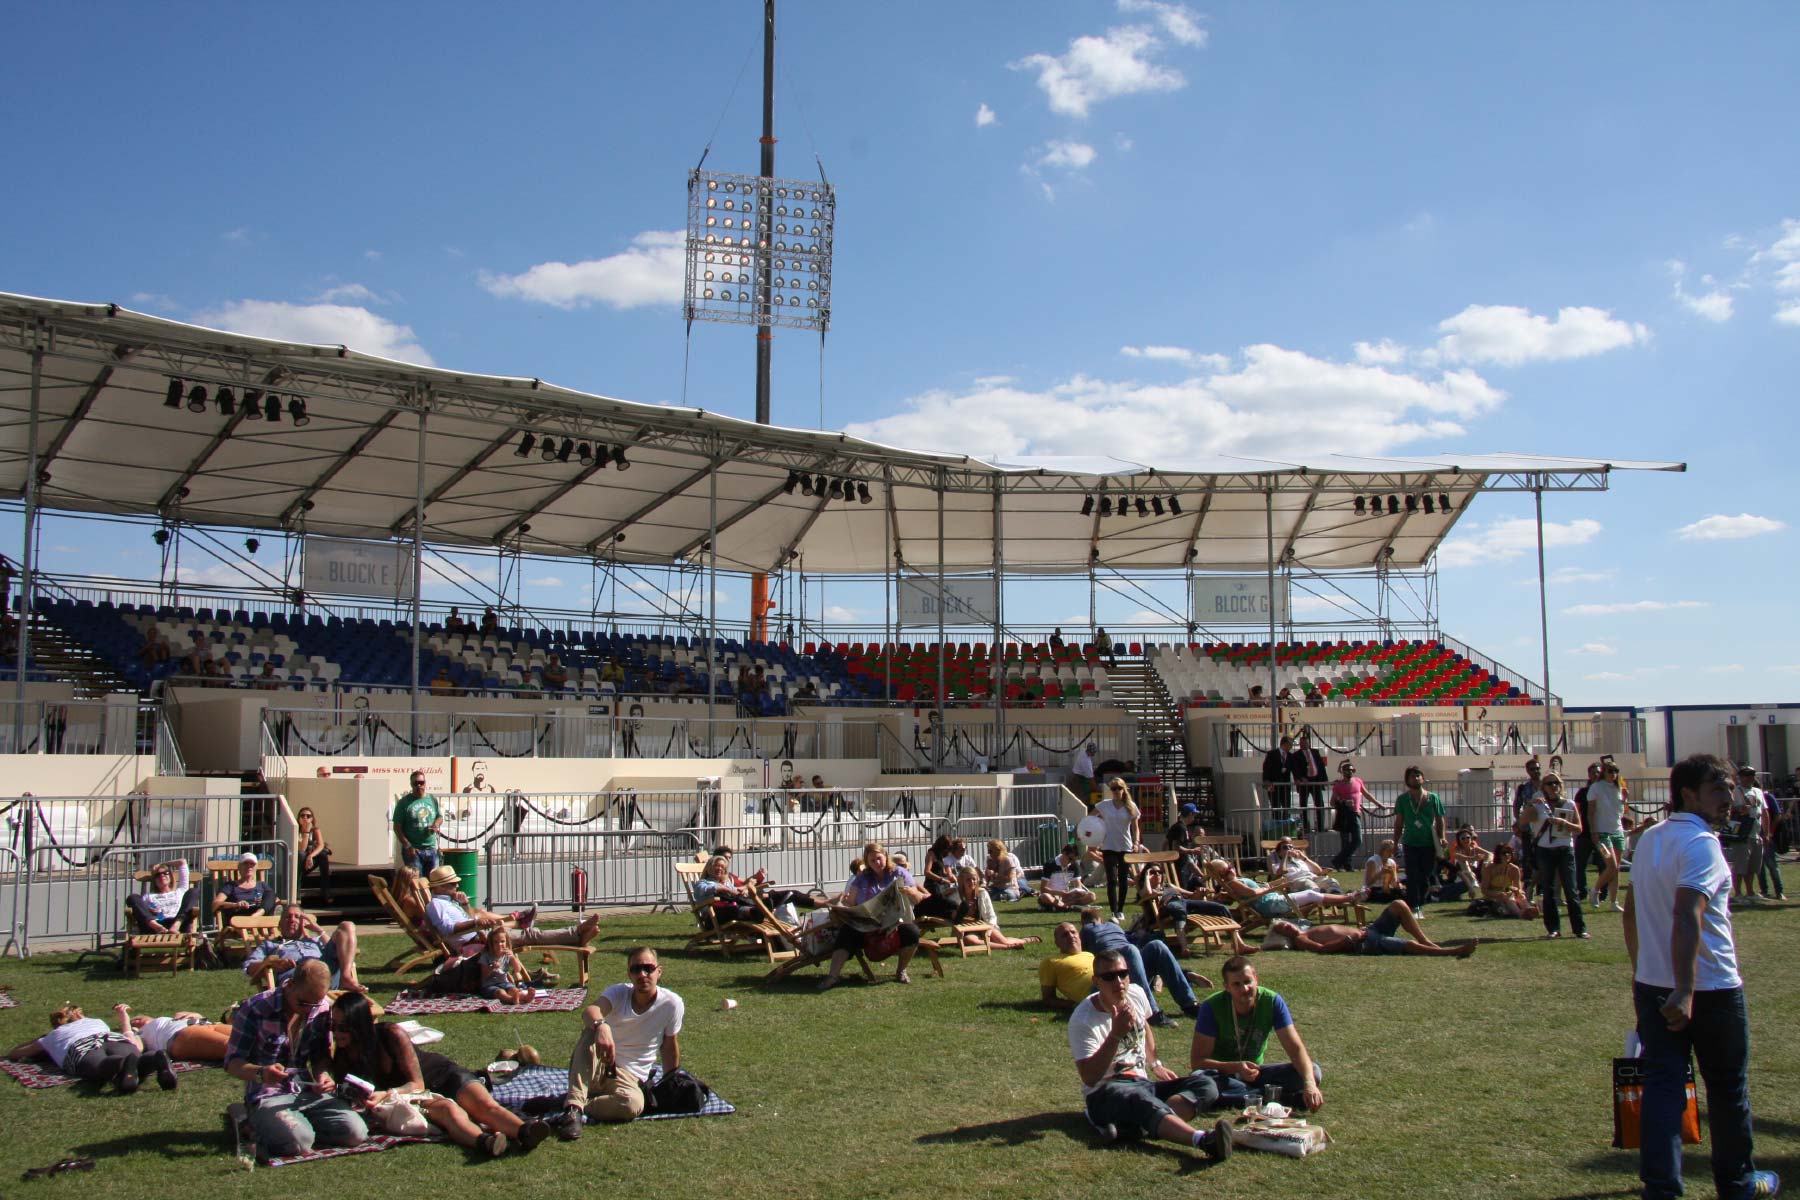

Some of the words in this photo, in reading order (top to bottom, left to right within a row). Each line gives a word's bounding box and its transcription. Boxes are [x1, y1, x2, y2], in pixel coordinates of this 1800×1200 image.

[328, 560, 376, 585] BLOCK
[381, 565, 389, 586] E
[922, 596, 962, 614] BLCK
[1215, 595, 1256, 613] BLOCK
[1260, 595, 1269, 613] G
